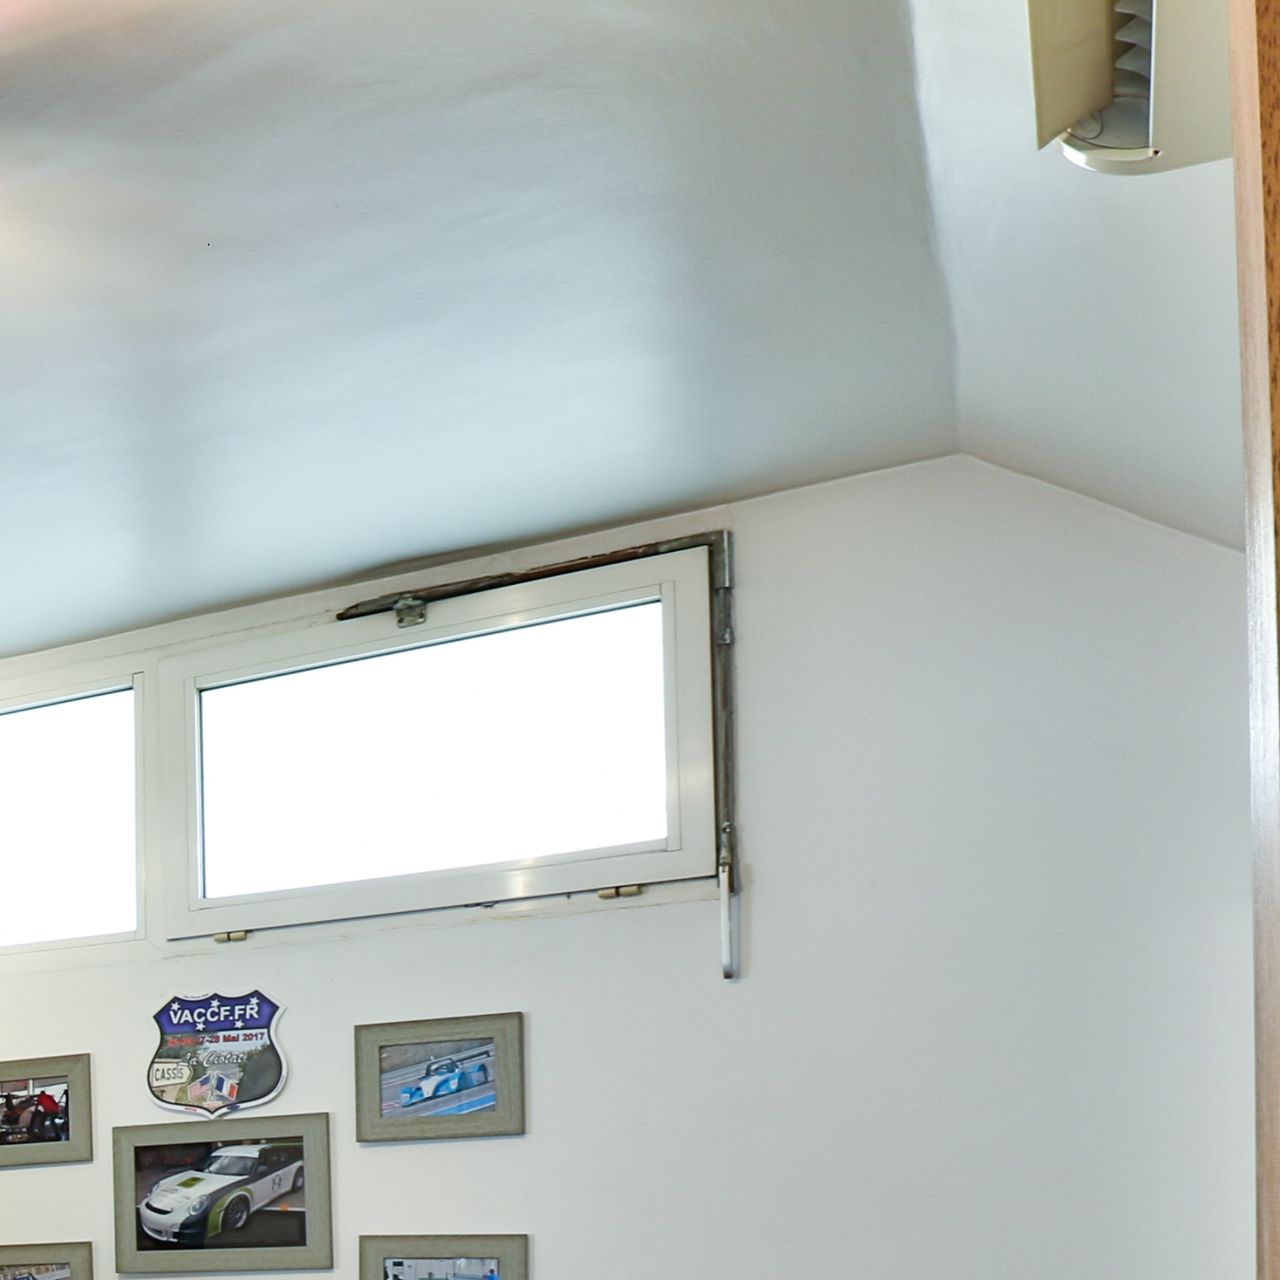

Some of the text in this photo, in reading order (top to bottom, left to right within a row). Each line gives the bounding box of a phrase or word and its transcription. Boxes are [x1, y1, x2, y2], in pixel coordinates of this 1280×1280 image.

[169, 1003, 260, 1025] VACCF.FR
[242, 1031, 266, 1042] 2017
[154, 1067, 184, 1081] CASSIS
